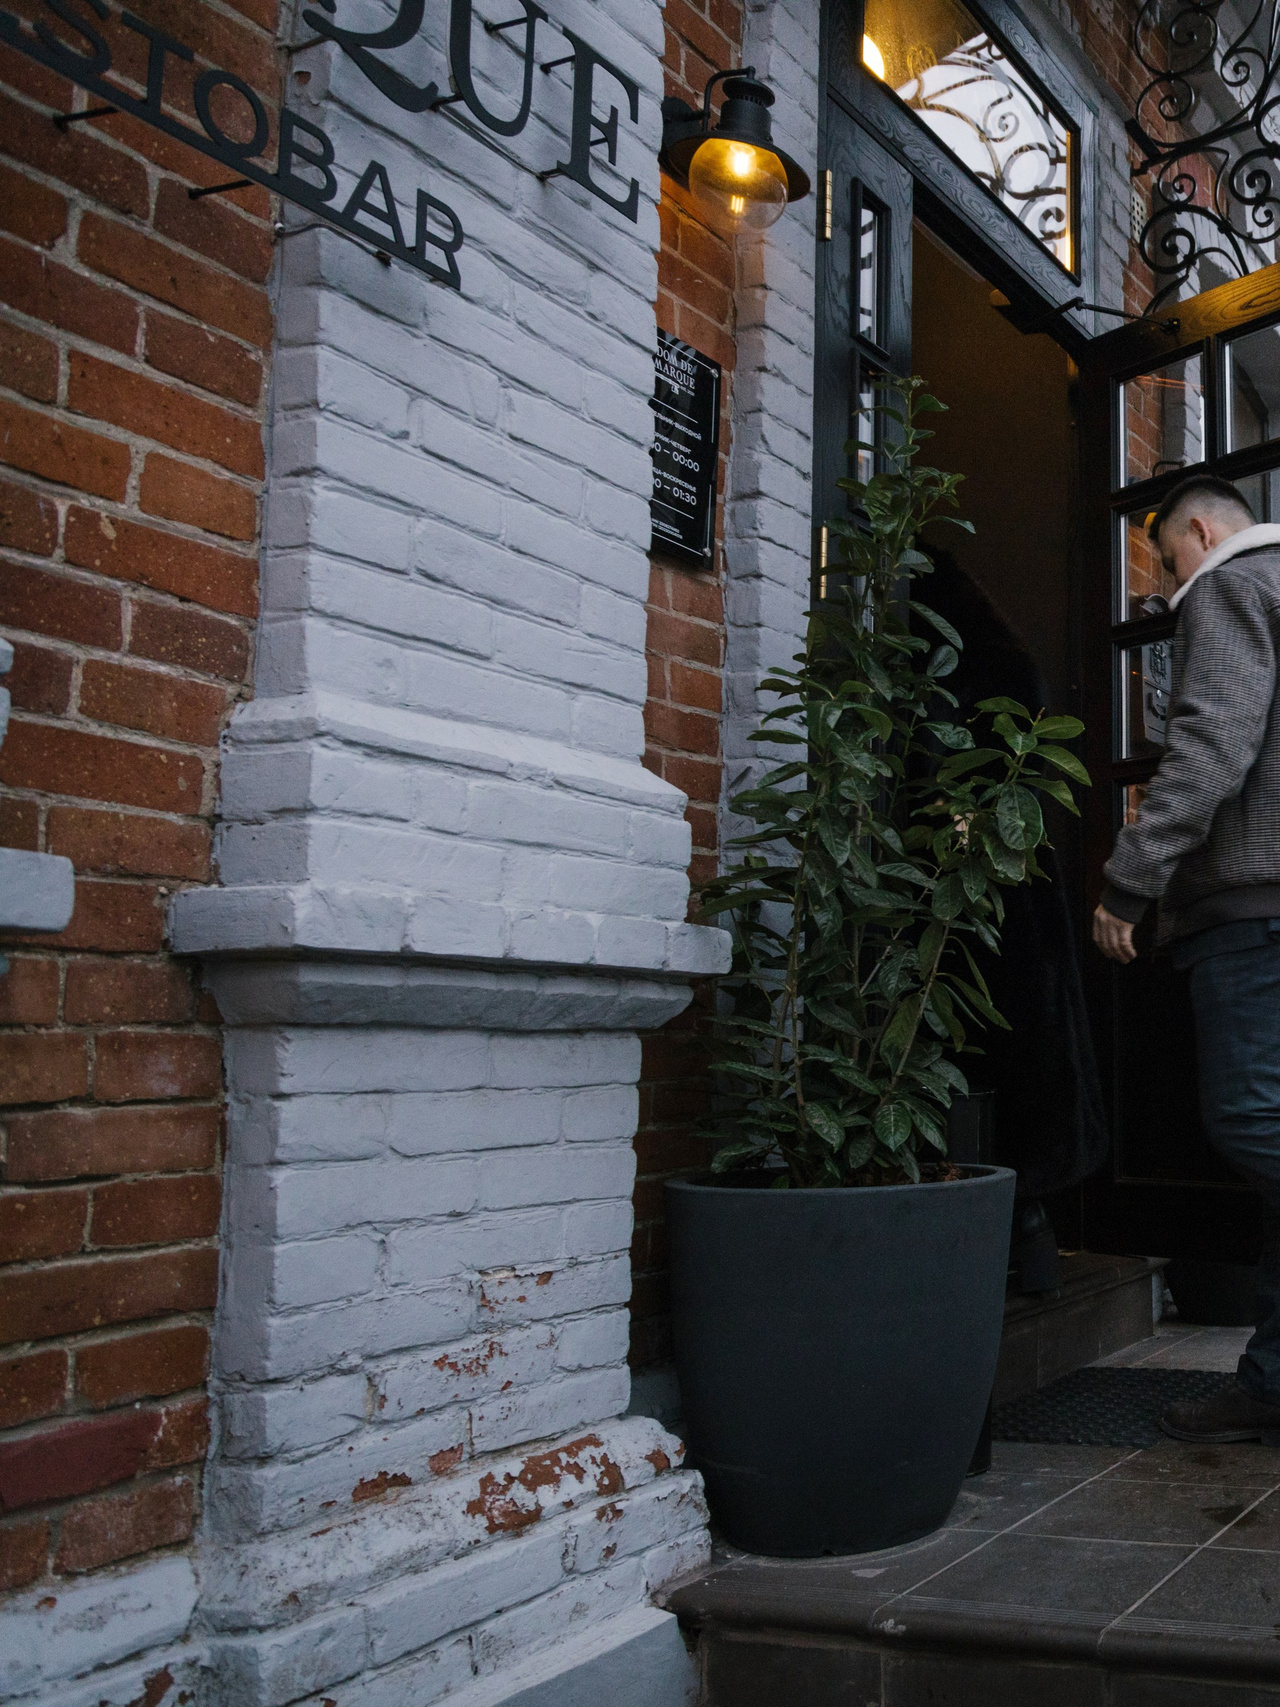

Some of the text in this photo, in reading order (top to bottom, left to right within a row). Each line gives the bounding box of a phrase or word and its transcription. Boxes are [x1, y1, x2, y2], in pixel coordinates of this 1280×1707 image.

[0, 0, 463, 290] STOBAR
[654, 357, 695, 389] MARQUE
[656, 345, 693, 376] DOM DE
[672, 451, 700, 472] 00:00
[672, 487, 697, 506] 01:30
